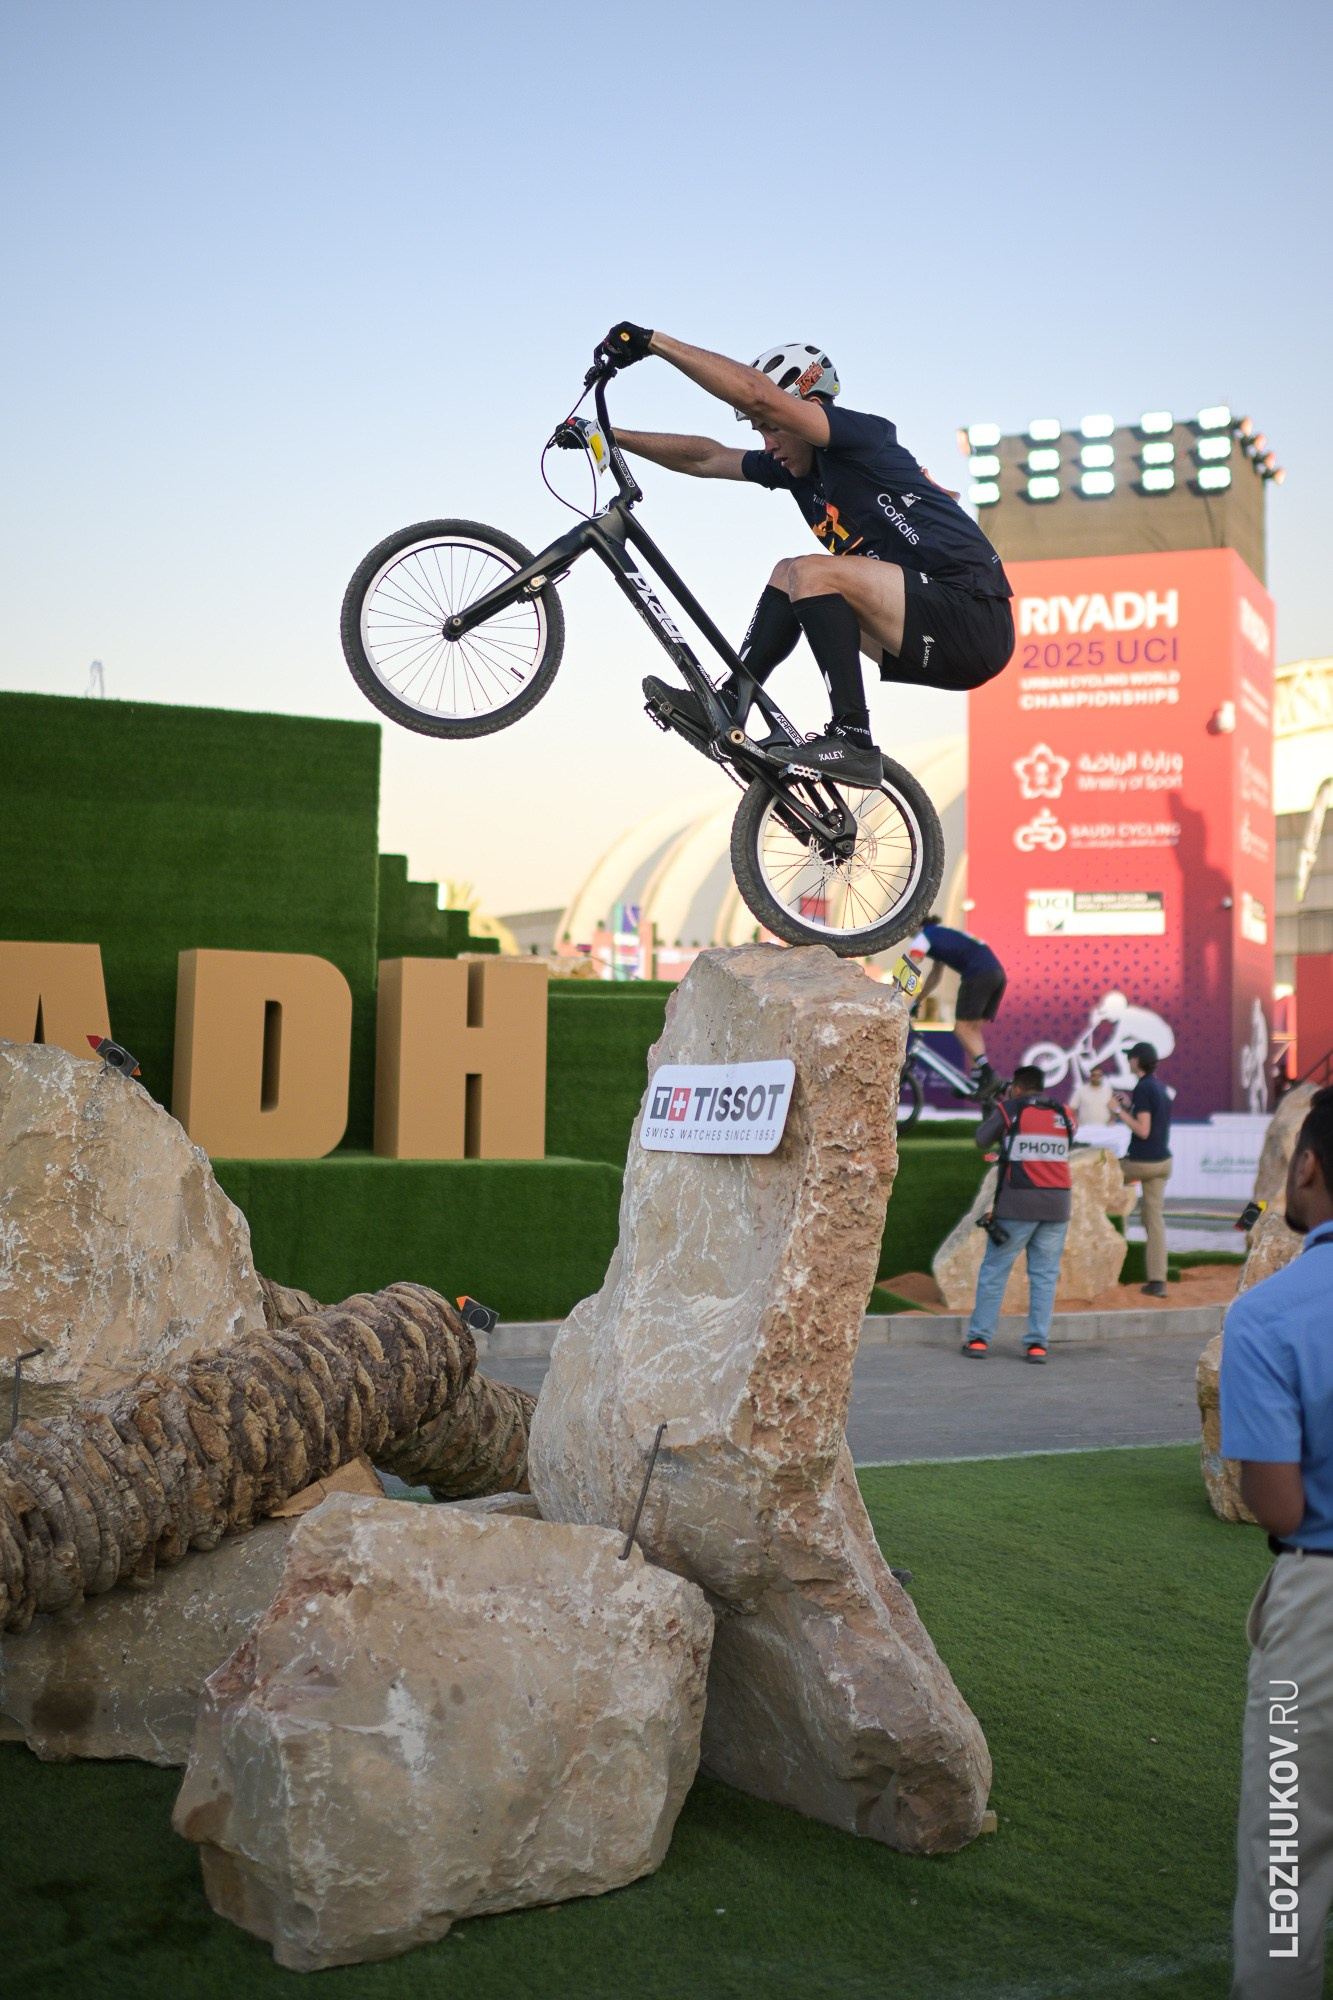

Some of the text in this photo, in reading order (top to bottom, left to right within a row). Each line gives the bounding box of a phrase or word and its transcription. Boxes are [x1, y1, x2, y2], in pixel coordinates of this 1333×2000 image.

[877, 493, 920, 546] Cofidis
[1020, 589, 1179, 636] RIYADH
[1023, 637, 1177, 669] 2025 UCI
[1020, 670, 1181, 691] URBAN CYCLING WORLD
[1020, 687, 1179, 710] CHAMPIONSHIPS
[776, 714, 805, 747] KARBO
[1070, 821, 1182, 839] SAUDI CYCLING
[1037, 896, 1069, 910] UCI
[694, 1084, 785, 1121] TISSOT
[645, 1127, 776, 1141] SWISS WATCHES SINCE 1853
[1019, 1142, 1066, 1156] PHOTO
